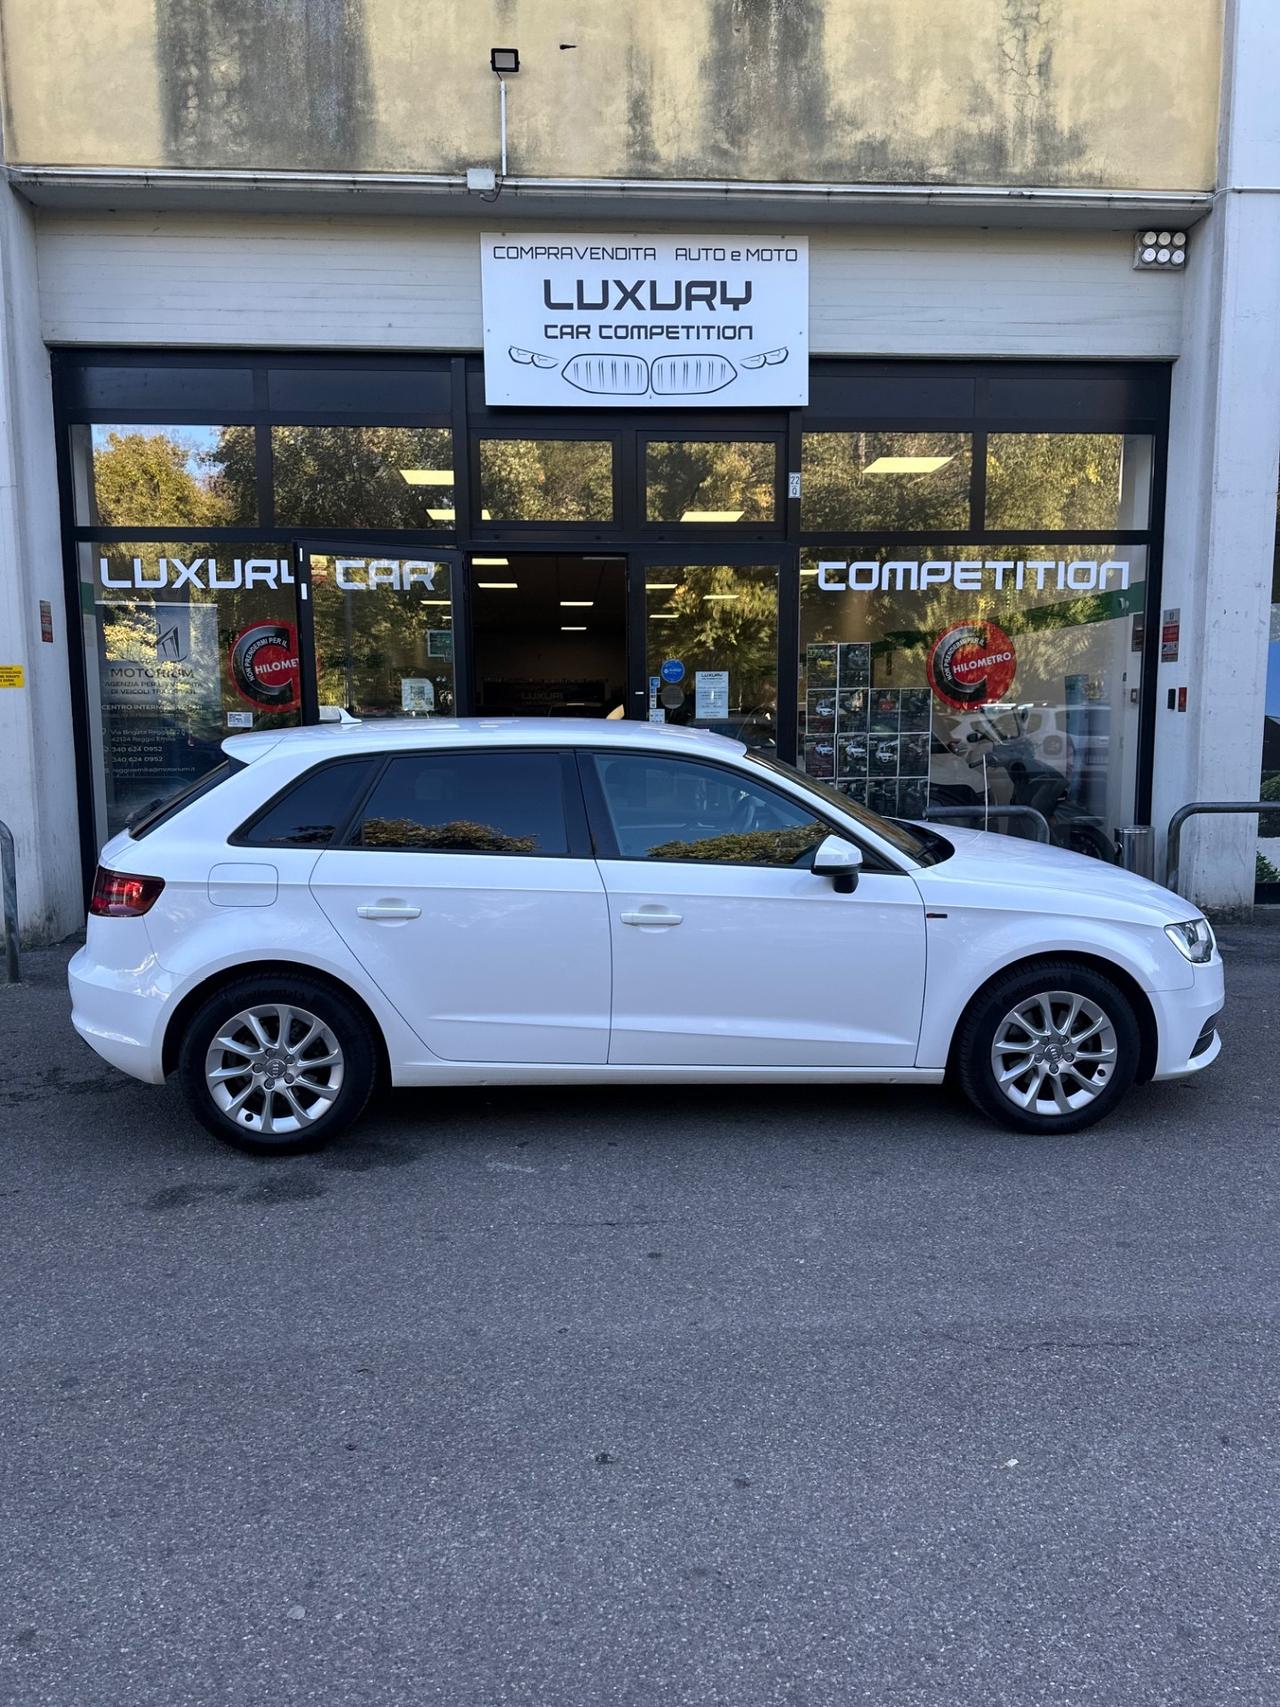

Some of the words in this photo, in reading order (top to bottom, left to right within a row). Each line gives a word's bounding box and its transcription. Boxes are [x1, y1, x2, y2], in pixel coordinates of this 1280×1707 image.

[493, 246, 657, 261] COMPRAVENDITA
[675, 247, 726, 261] AUTO
[730, 250, 741, 262] e
[746, 248, 798, 262] MOTO
[543, 278, 753, 312] LUXURY
[544, 324, 592, 340] CAR
[599, 324, 753, 340] COMPETITION
[335, 559, 435, 591] CAR
[817, 560, 1130, 591] COMPETITION
[268, 636, 282, 645] PER
